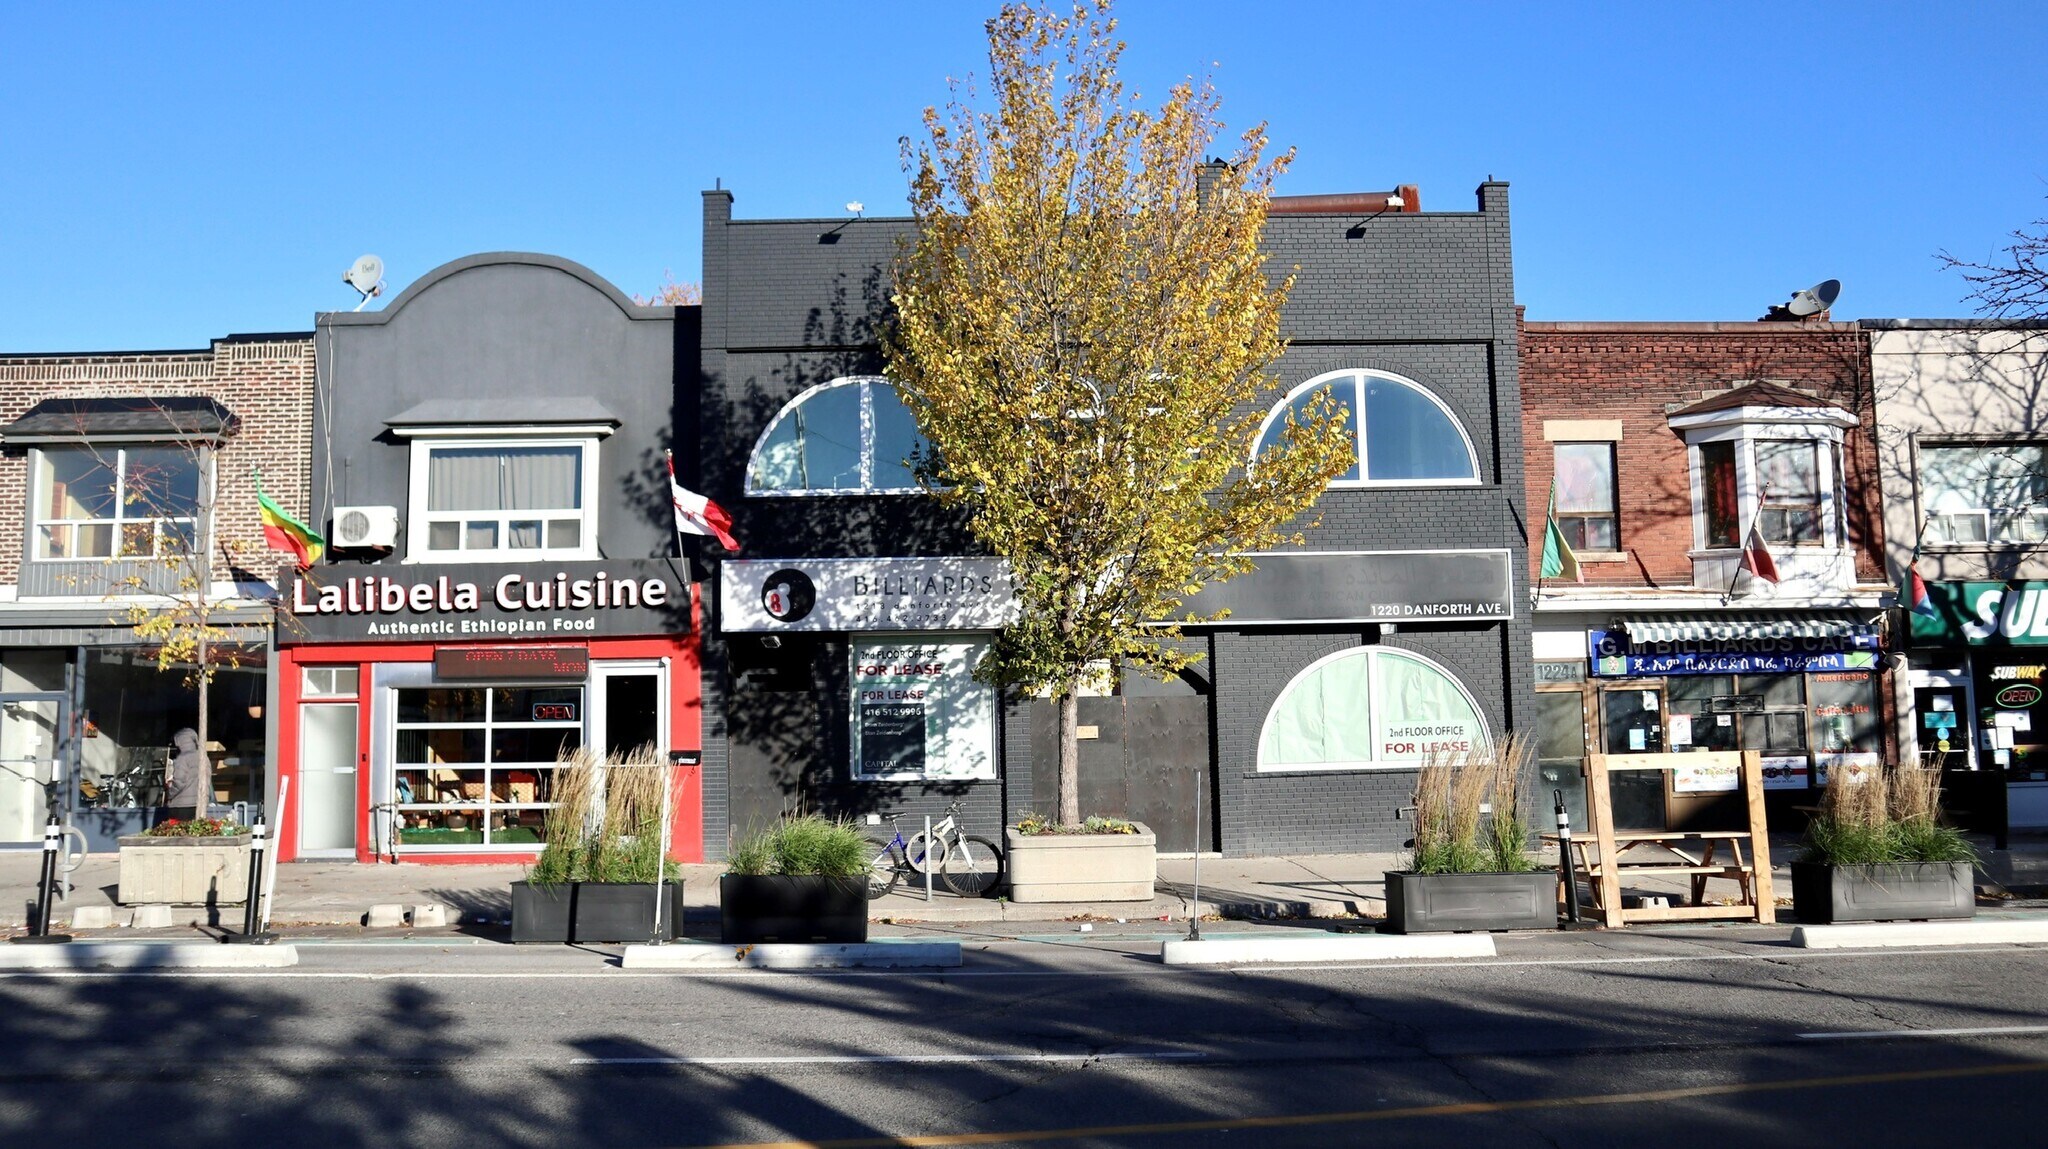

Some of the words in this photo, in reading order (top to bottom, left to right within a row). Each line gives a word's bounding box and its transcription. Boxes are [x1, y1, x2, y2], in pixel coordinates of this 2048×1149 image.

[293, 575, 479, 614] Lalibela
[495, 571, 667, 610] Cuisine
[854, 576, 992, 596] BILLIARDS
[1370, 605, 1400, 616] 1220
[1404, 603, 1472, 616] DANFORTH
[1476, 602, 1505, 614] AVE.
[367, 621, 454, 635] Authentic
[461, 618, 547, 635] Ethiopian
[553, 617, 595, 631] Food
[1656, 638, 1794, 654] BILLIARDS
[1802, 635, 1870, 651] CAFE
[465, 650, 503, 661] OPEN
[507, 650, 514, 661] 7
[518, 650, 558, 661] DAYS
[861, 651, 875, 660] 2nd
[877, 649, 904, 660] FLOOR
[907, 649, 938, 659] OFFICE
[554, 662, 586, 672] MON
[856, 665, 888, 676] FOR
[894, 664, 943, 676] LEASE
[1989, 663, 2047, 681] SUBWAY
[1815, 673, 1869, 682] Americano
[861, 691, 884, 701] FOR
[888, 690, 925, 700] LEASE
[2001, 690, 2036, 702] OPEN
[535, 706, 573, 720] OPEN
[865, 708, 880, 717] 416
[882, 708, 899, 716] 512
[900, 707, 922, 716] 9996
[1389, 728, 1403, 738] 2nd
[1405, 726, 1434, 737] FLOOR
[1435, 725, 1464, 736] OFFICE
[1385, 742, 1415, 754] FOR
[1421, 741, 1469, 753] LEASE
